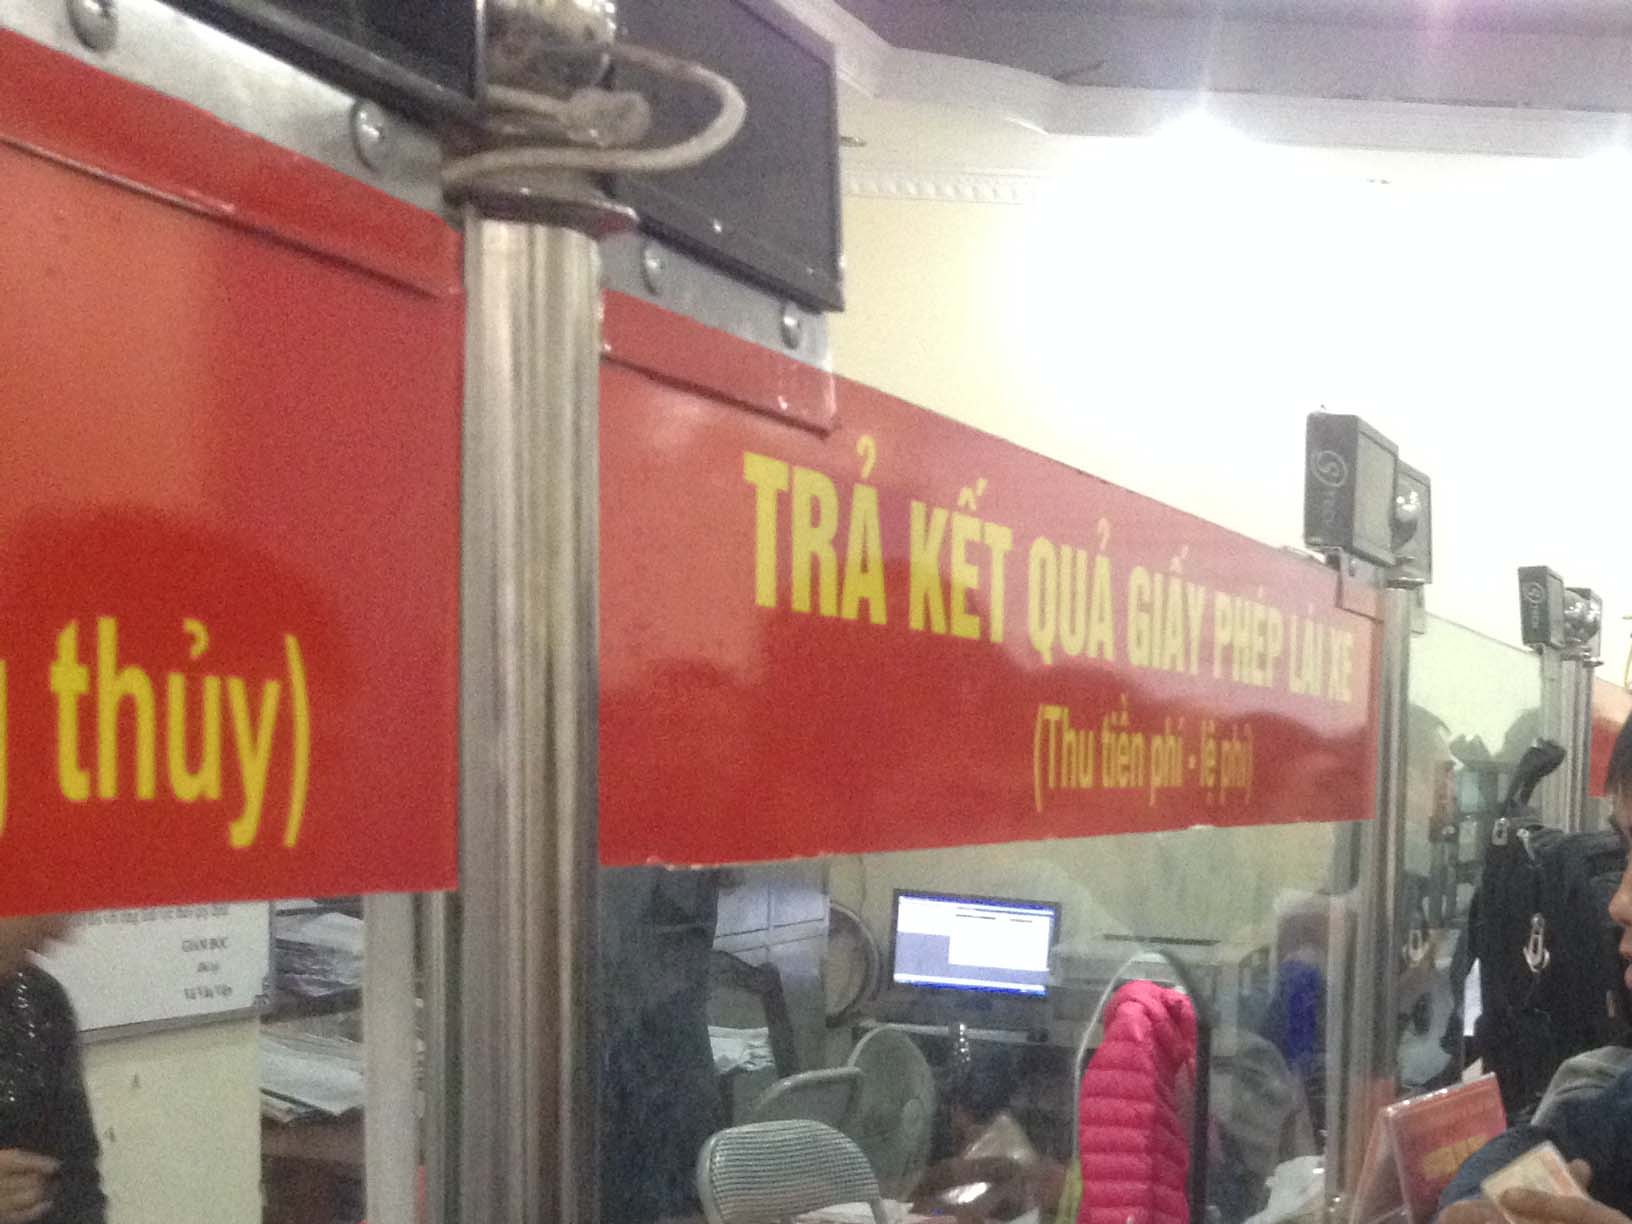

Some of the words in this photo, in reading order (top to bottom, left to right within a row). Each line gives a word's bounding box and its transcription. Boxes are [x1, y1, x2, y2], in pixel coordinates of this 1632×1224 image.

[743, 434, 888, 625] TRẢ
[908, 477, 1014, 644] KẾT
[1027, 517, 1115, 665] QUẢ
[1126, 545, 1206, 677] GIẤY
[1212, 584, 1284, 689] PHÉP
[50, 617, 312, 849] thủy)
[1034, 703, 1095, 812] (Thu
[1101, 692, 1145, 789] tiền
